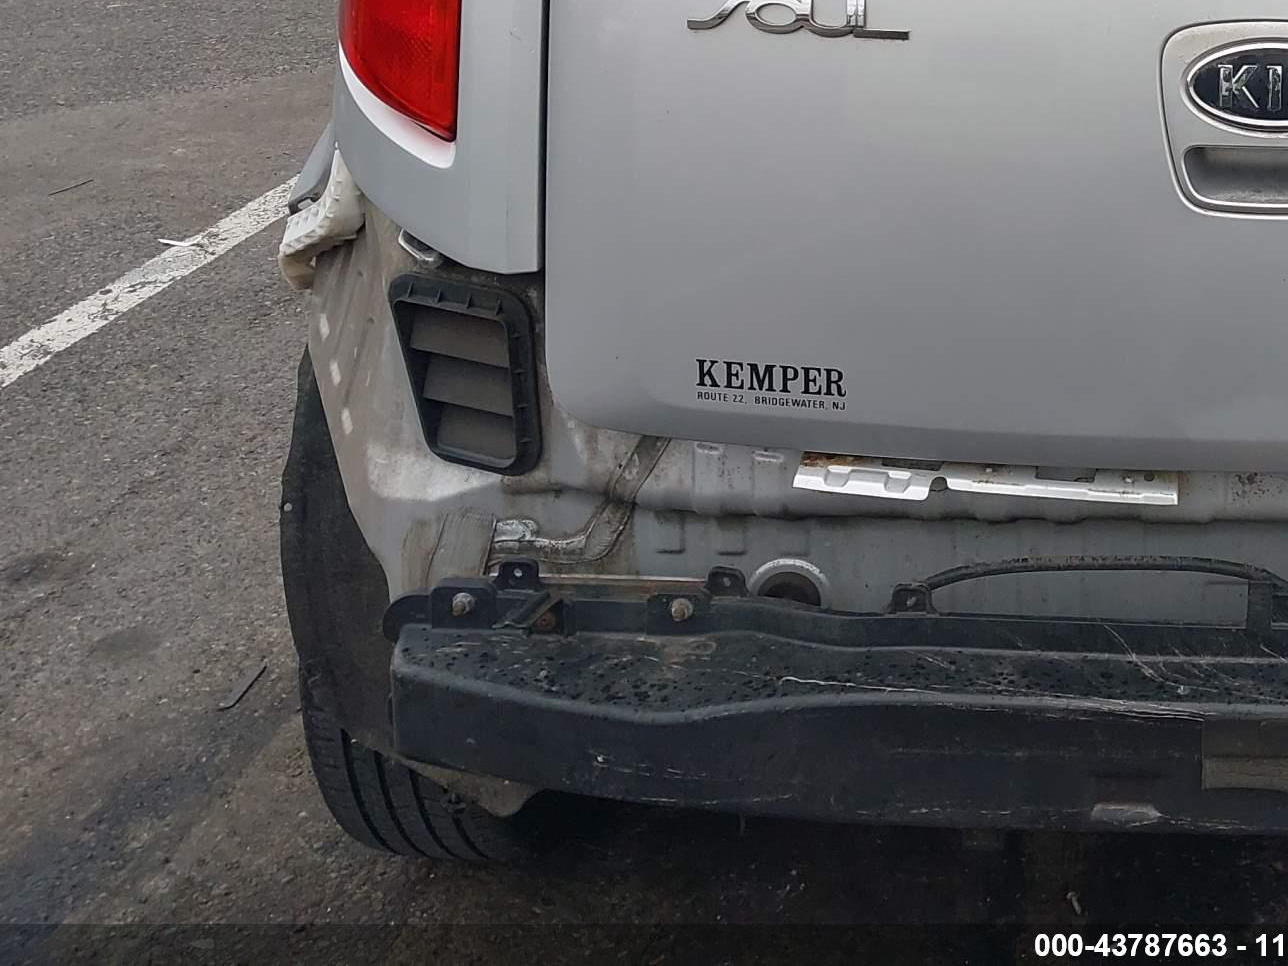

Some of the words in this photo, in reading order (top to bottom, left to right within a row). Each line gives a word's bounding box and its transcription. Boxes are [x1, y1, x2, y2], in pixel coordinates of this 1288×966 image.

[696, 358, 847, 397] KEMPER
[697, 391, 729, 403] ROUTE
[832, 401, 846, 411] NJ
